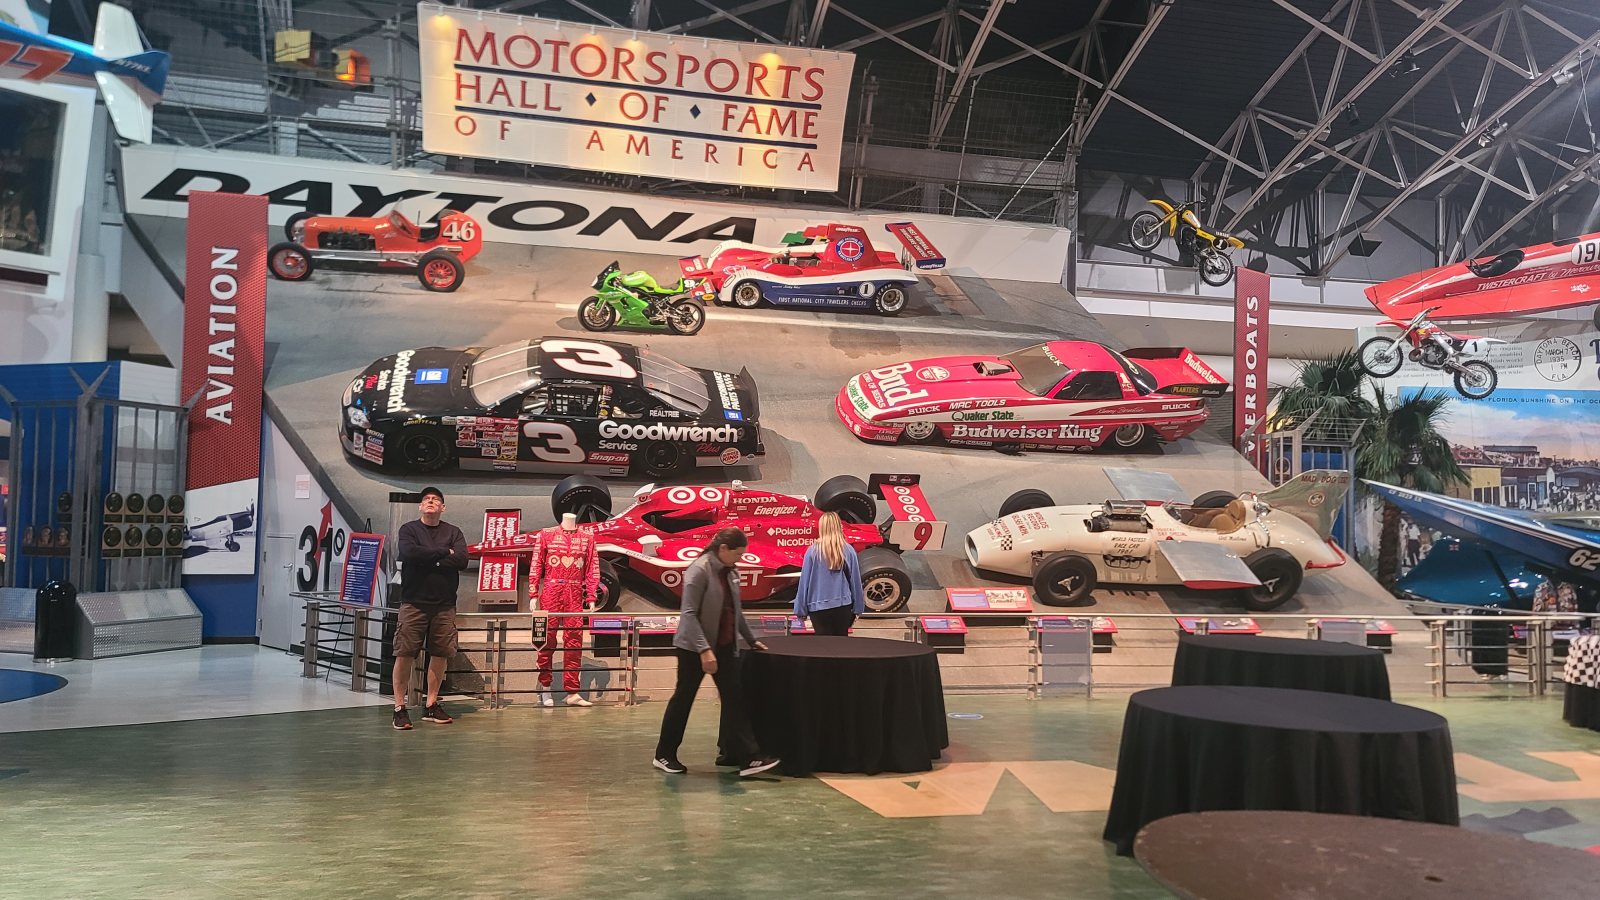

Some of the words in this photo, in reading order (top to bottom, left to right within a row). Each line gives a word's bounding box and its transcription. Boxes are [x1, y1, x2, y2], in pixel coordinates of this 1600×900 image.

[454, 28, 825, 101] MOTORSPORTS
[455, 72, 562, 112] HALL
[619, 92, 669, 123] OF
[722, 104, 819, 139] FAME
[454, 115, 512, 141] OF
[586, 130, 815, 172] AMERICA
[140, 168, 758, 244] DAYTONA
[443, 221, 476, 241] 46
[1216, 239, 1224, 249] 1
[863, 285, 869, 294] 1
[1476, 272, 1548, 291] TWISTERCRAFT
[205, 246, 240, 424] AVIATION
[1041, 345, 1063, 367] BUICK
[1471, 341, 1478, 352] 1
[1535, 338, 1558, 365] DAYTONA
[1561, 339, 1580, 361] BEACH
[539, 340, 638, 378] 3
[1183, 352, 1222, 384] Budweiser
[377, 369, 392, 391] Service
[387, 350, 416, 413] Goodwrench
[862, 372, 873, 383] KING
[868, 381, 877, 390] OF
[870, 362, 929, 407] Bud
[1120, 372, 1130, 384] 1
[713, 371, 732, 410] PERFORMANCE
[848, 379, 858, 398] Quaker
[854, 397, 869, 412] State
[871, 389, 886, 409] BEERS
[1172, 386, 1200, 394] PLANTERS
[728, 391, 741, 411] PARTS
[908, 405, 940, 415] BUICK
[949, 401, 973, 410] MAC
[975, 399, 1007, 408] TOOLS
[650, 410, 680, 418] REALTREE
[951, 411, 989, 421] Quaker
[991, 411, 1015, 421] State
[459, 432, 476, 441] 3M
[598, 419, 738, 443] Goodwrench
[951, 424, 1057, 439] Budweiser
[1057, 424, 1104, 443] King
[523, 421, 586, 463] 3
[598, 440, 639, 451] Service
[696, 442, 721, 453] Plus
[589, 452, 629, 463] Snap-on
[722, 454, 739, 462] KING
[1301, 475, 1317, 483] MAD
[1320, 475, 1337, 484] DOG
[733, 496, 778, 504] HONDA
[754, 505, 798, 516] Energizer
[775, 527, 812, 536] Polaroid
[914, 522, 933, 550] 9
[1568, 549, 1600, 571] 62
[492, 567, 502, 590] Polaroid
[502, 562, 515, 589] Energizer
